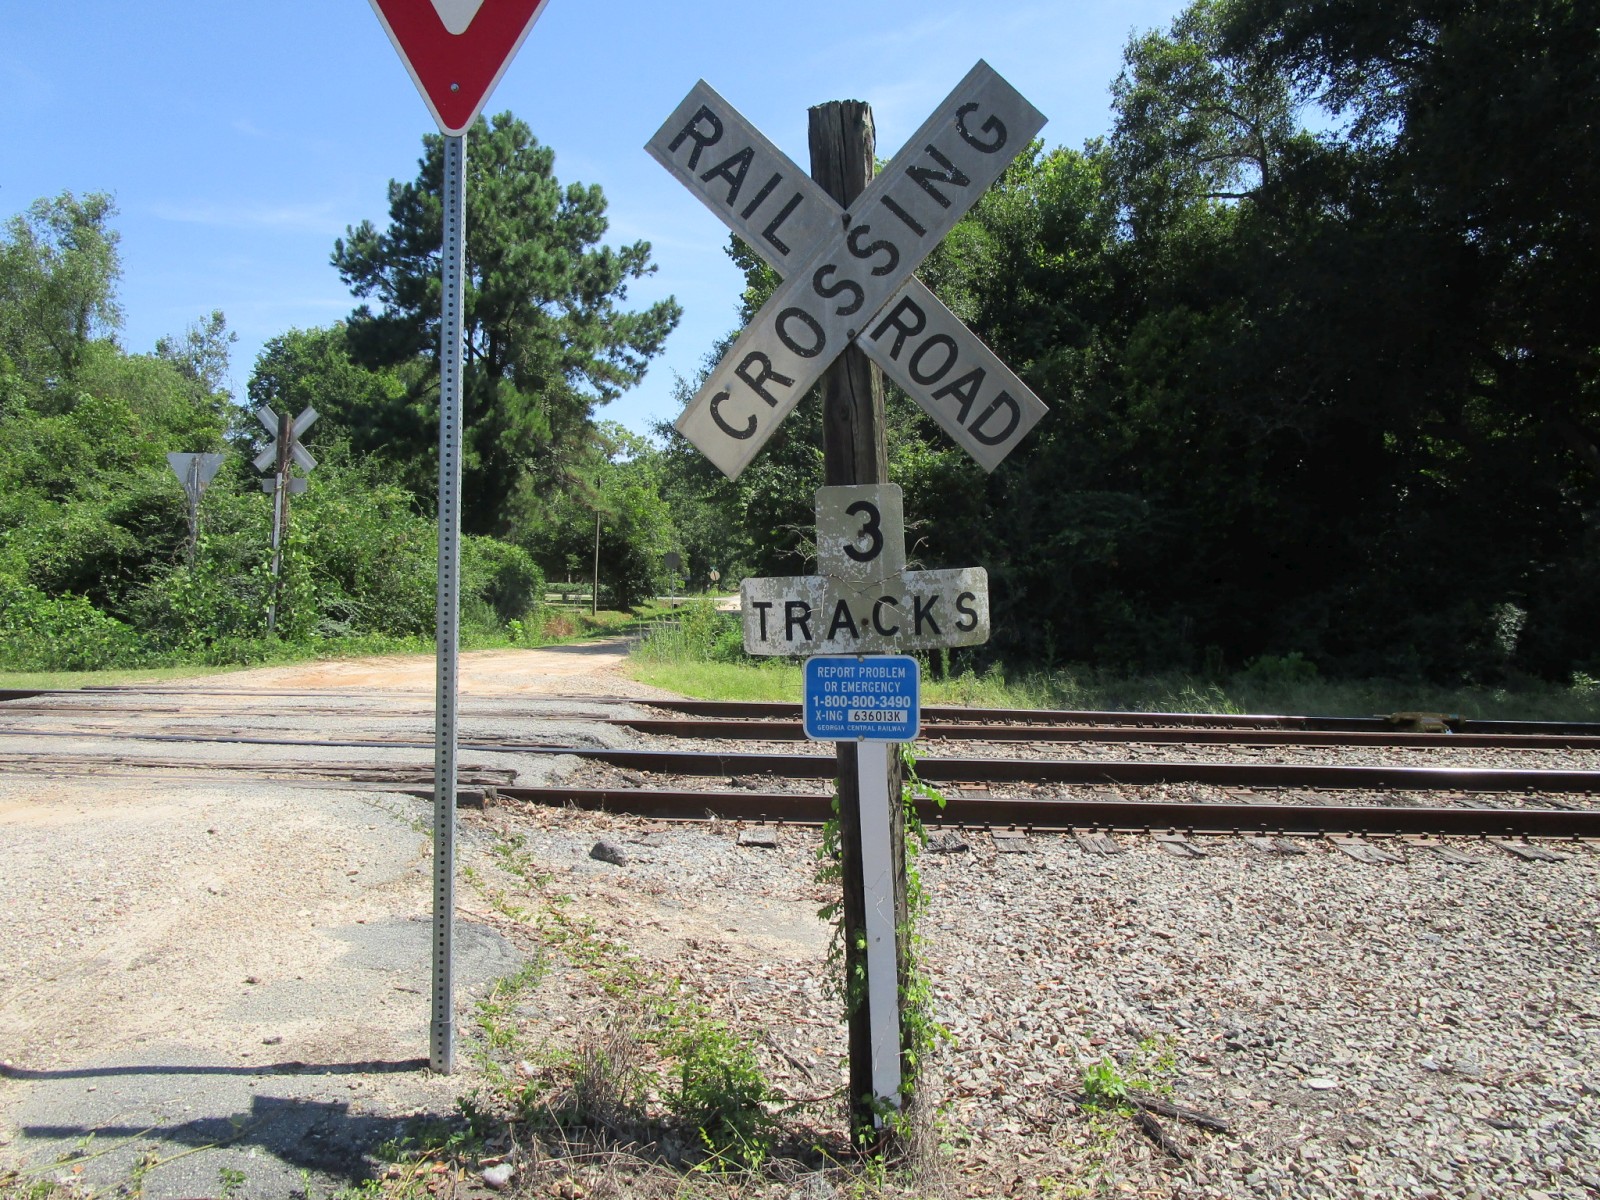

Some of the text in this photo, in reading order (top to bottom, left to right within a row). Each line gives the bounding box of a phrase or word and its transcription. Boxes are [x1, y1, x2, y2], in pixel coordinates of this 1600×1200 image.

[668, 104, 1021, 447] RAIL ROAD
[709, 102, 1008, 440] CROSSING
[843, 501, 884, 563] 3
[752, 591, 979, 642] TRACKS
[817, 666, 906, 678] REPORT PROBLEM
[824, 681, 901, 693] OR EMERGENCY
[813, 695, 911, 708] 1-800-800-3490
[815, 710, 901, 722] X-ING 636013K
[847, 724, 876, 732] CENTRAL
